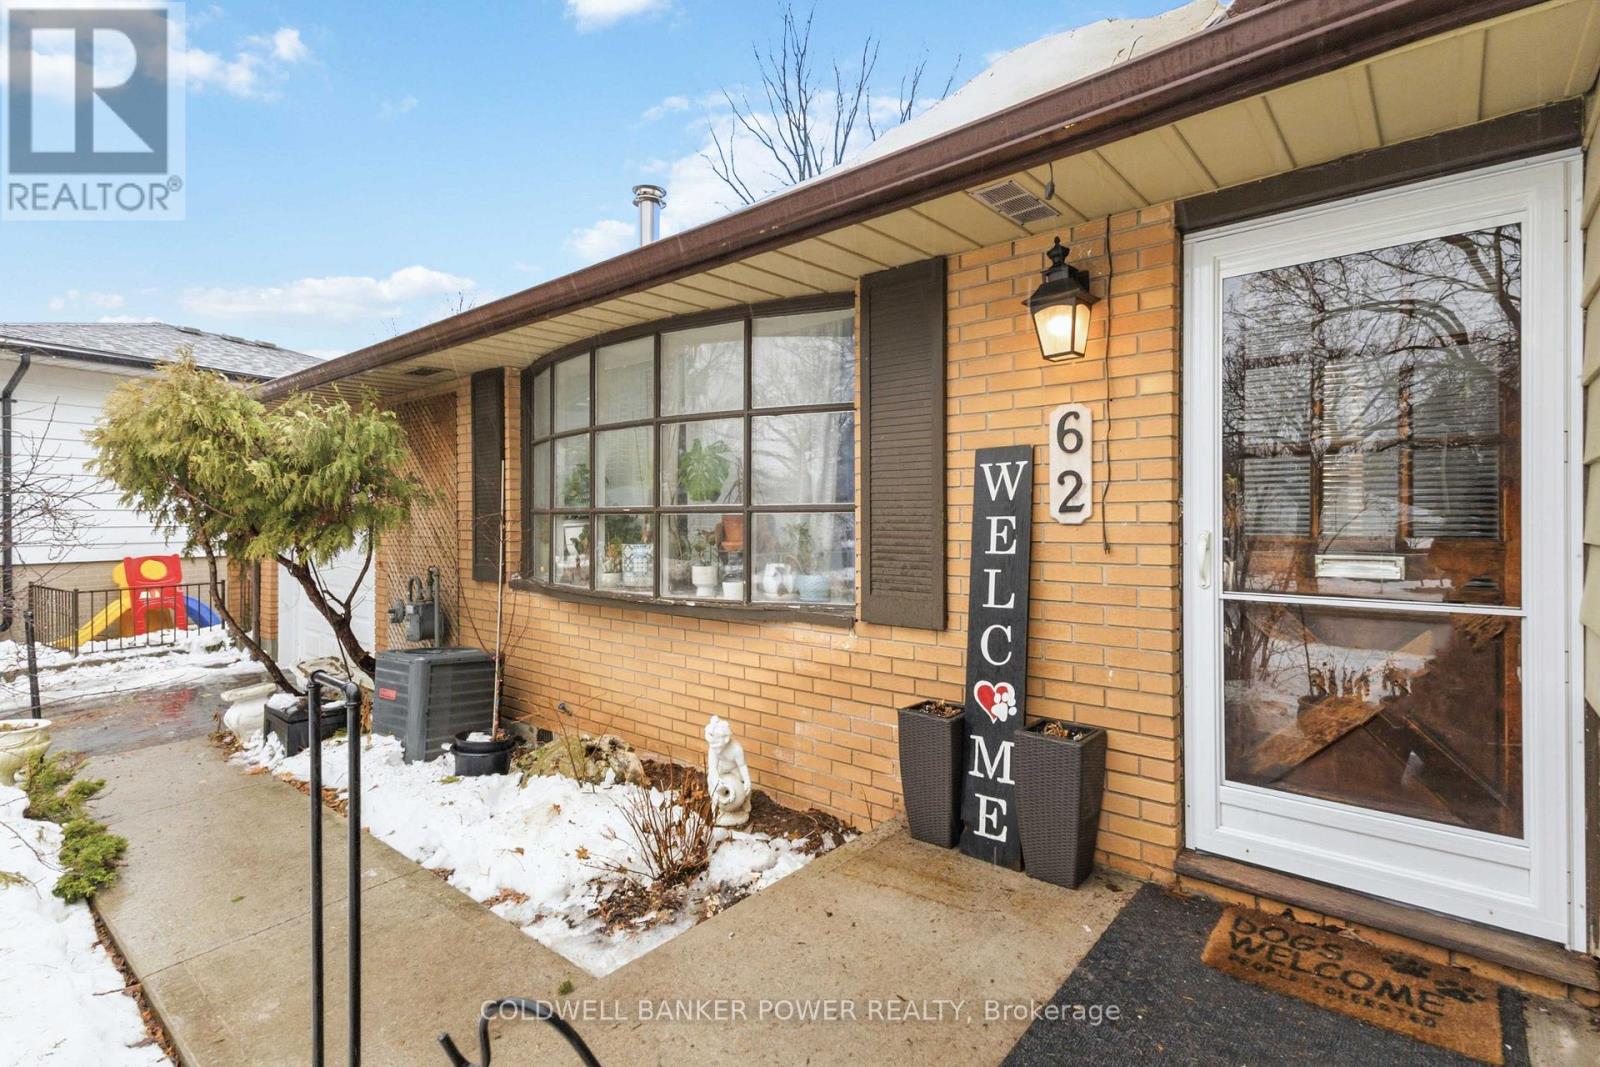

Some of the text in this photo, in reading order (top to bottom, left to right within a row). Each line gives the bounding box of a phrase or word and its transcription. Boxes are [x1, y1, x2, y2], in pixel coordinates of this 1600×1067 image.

[1056, 410, 1086, 514] 62
[968, 461, 1028, 844] WELCME
[1229, 931, 1445, 1017] WELCOME
[1233, 915, 1344, 961] DOGS
